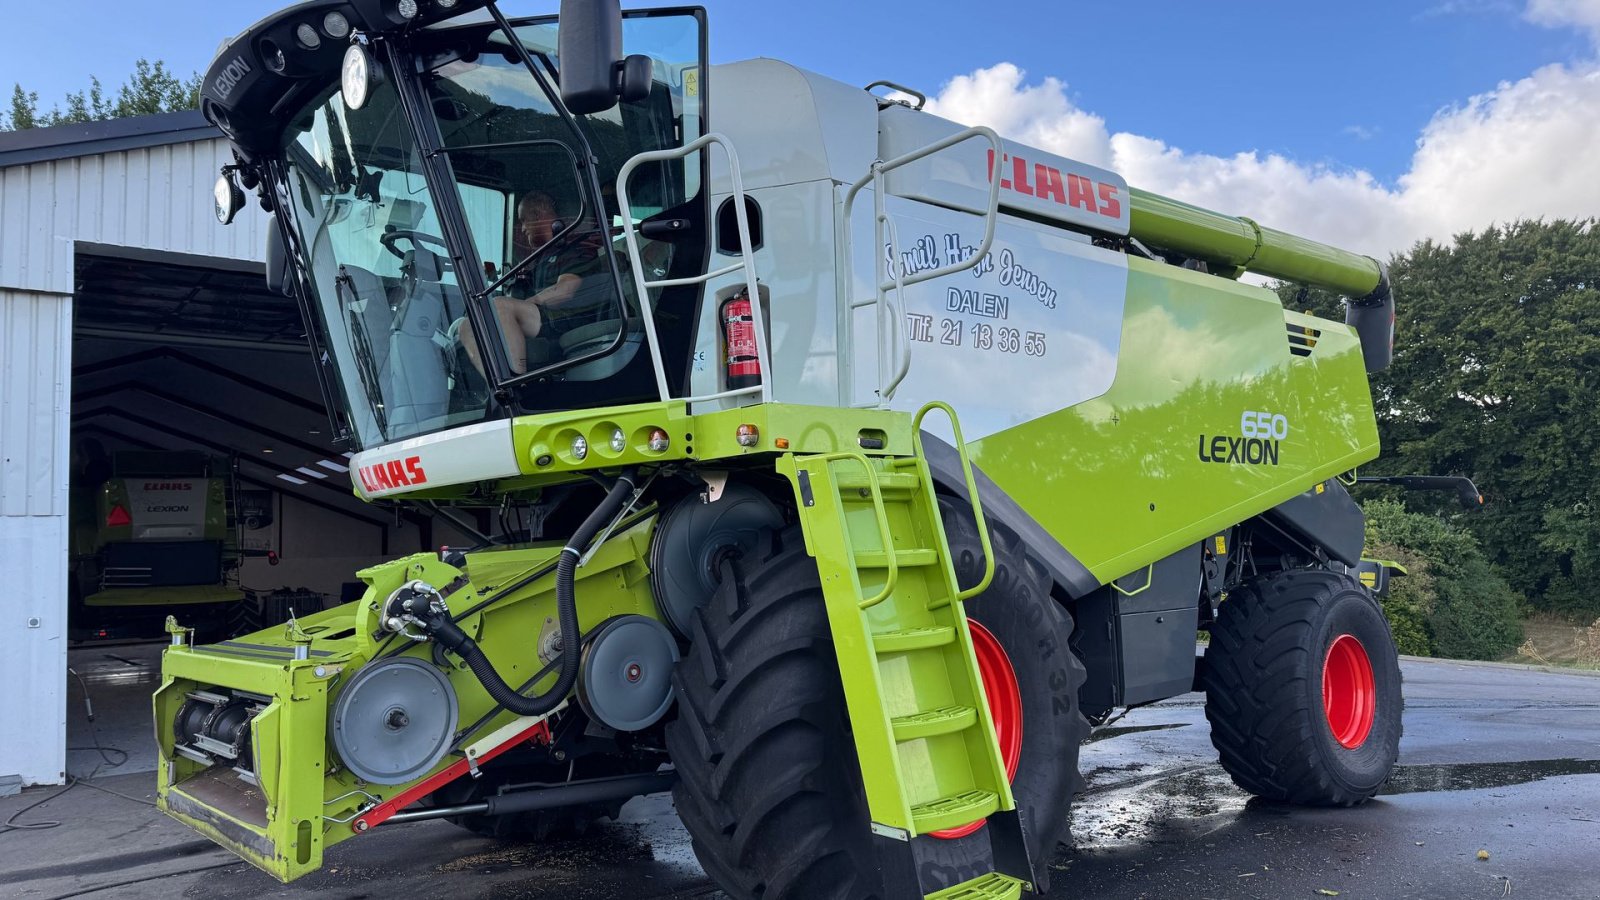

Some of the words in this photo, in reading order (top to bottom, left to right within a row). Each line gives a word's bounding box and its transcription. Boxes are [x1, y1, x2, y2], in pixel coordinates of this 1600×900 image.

[212, 55, 251, 99] LEXION
[987, 148, 1121, 219] CLAAS
[999, 248, 1058, 309] Jensen
[946, 287, 1009, 319] DALEN
[941, 318, 963, 346] 21
[971, 323, 993, 350] 13
[998, 327, 1020, 354] 36
[1025, 331, 1046, 357] 55
[1241, 410, 1288, 440] 650
[1199, 435, 1278, 465] LEXION
[143, 482, 193, 491] CLAAS
[359, 456, 427, 493] CLAAS
[146, 505, 189, 513] LEXION
[1047, 668, 1071, 717] 32
